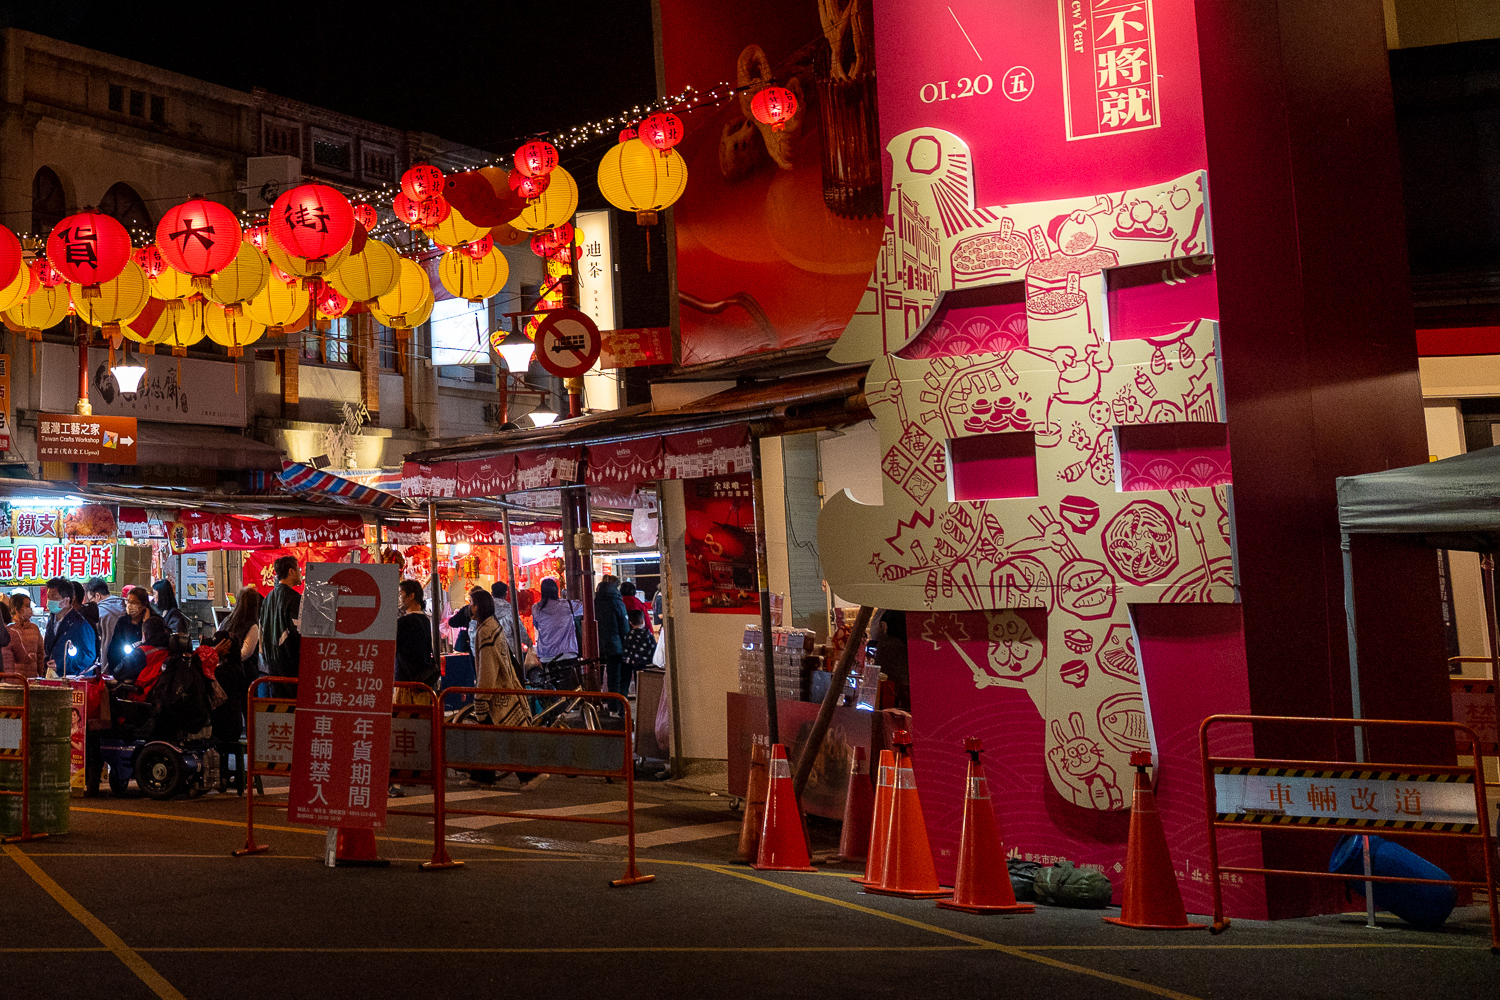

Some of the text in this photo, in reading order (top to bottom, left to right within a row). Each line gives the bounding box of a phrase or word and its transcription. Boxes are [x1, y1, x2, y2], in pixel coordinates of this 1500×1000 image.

[1073, 19, 1088, 53] Year
[919, 72, 1028, 104] 01.20 五
[284, 203, 330, 234] 街
[58, 226, 98, 270] 貨
[169, 218, 215, 252] 大
[586, 240, 603, 279] 迪茶
[40, 421, 100, 436] 臺灣工藝之家
[904, 431, 926, 452] 福
[885, 455, 903, 478] 春
[17, 511, 57, 537] 鐵支
[317, 642, 379, 658] 1/2 1/5
[320, 659, 375, 675] 0時-24時
[315, 675, 383, 691] 1/6 1/20
[314, 692, 377, 708] 12時-24時
[1466, 703, 1497, 731] 禁
[267, 722, 292, 752] 禁
[392, 728, 417, 757] 車
[307, 715, 334, 806] 車輛禁入
[348, 717, 375, 809] 年貨期間
[1267, 782, 1423, 816] 車輛改道
